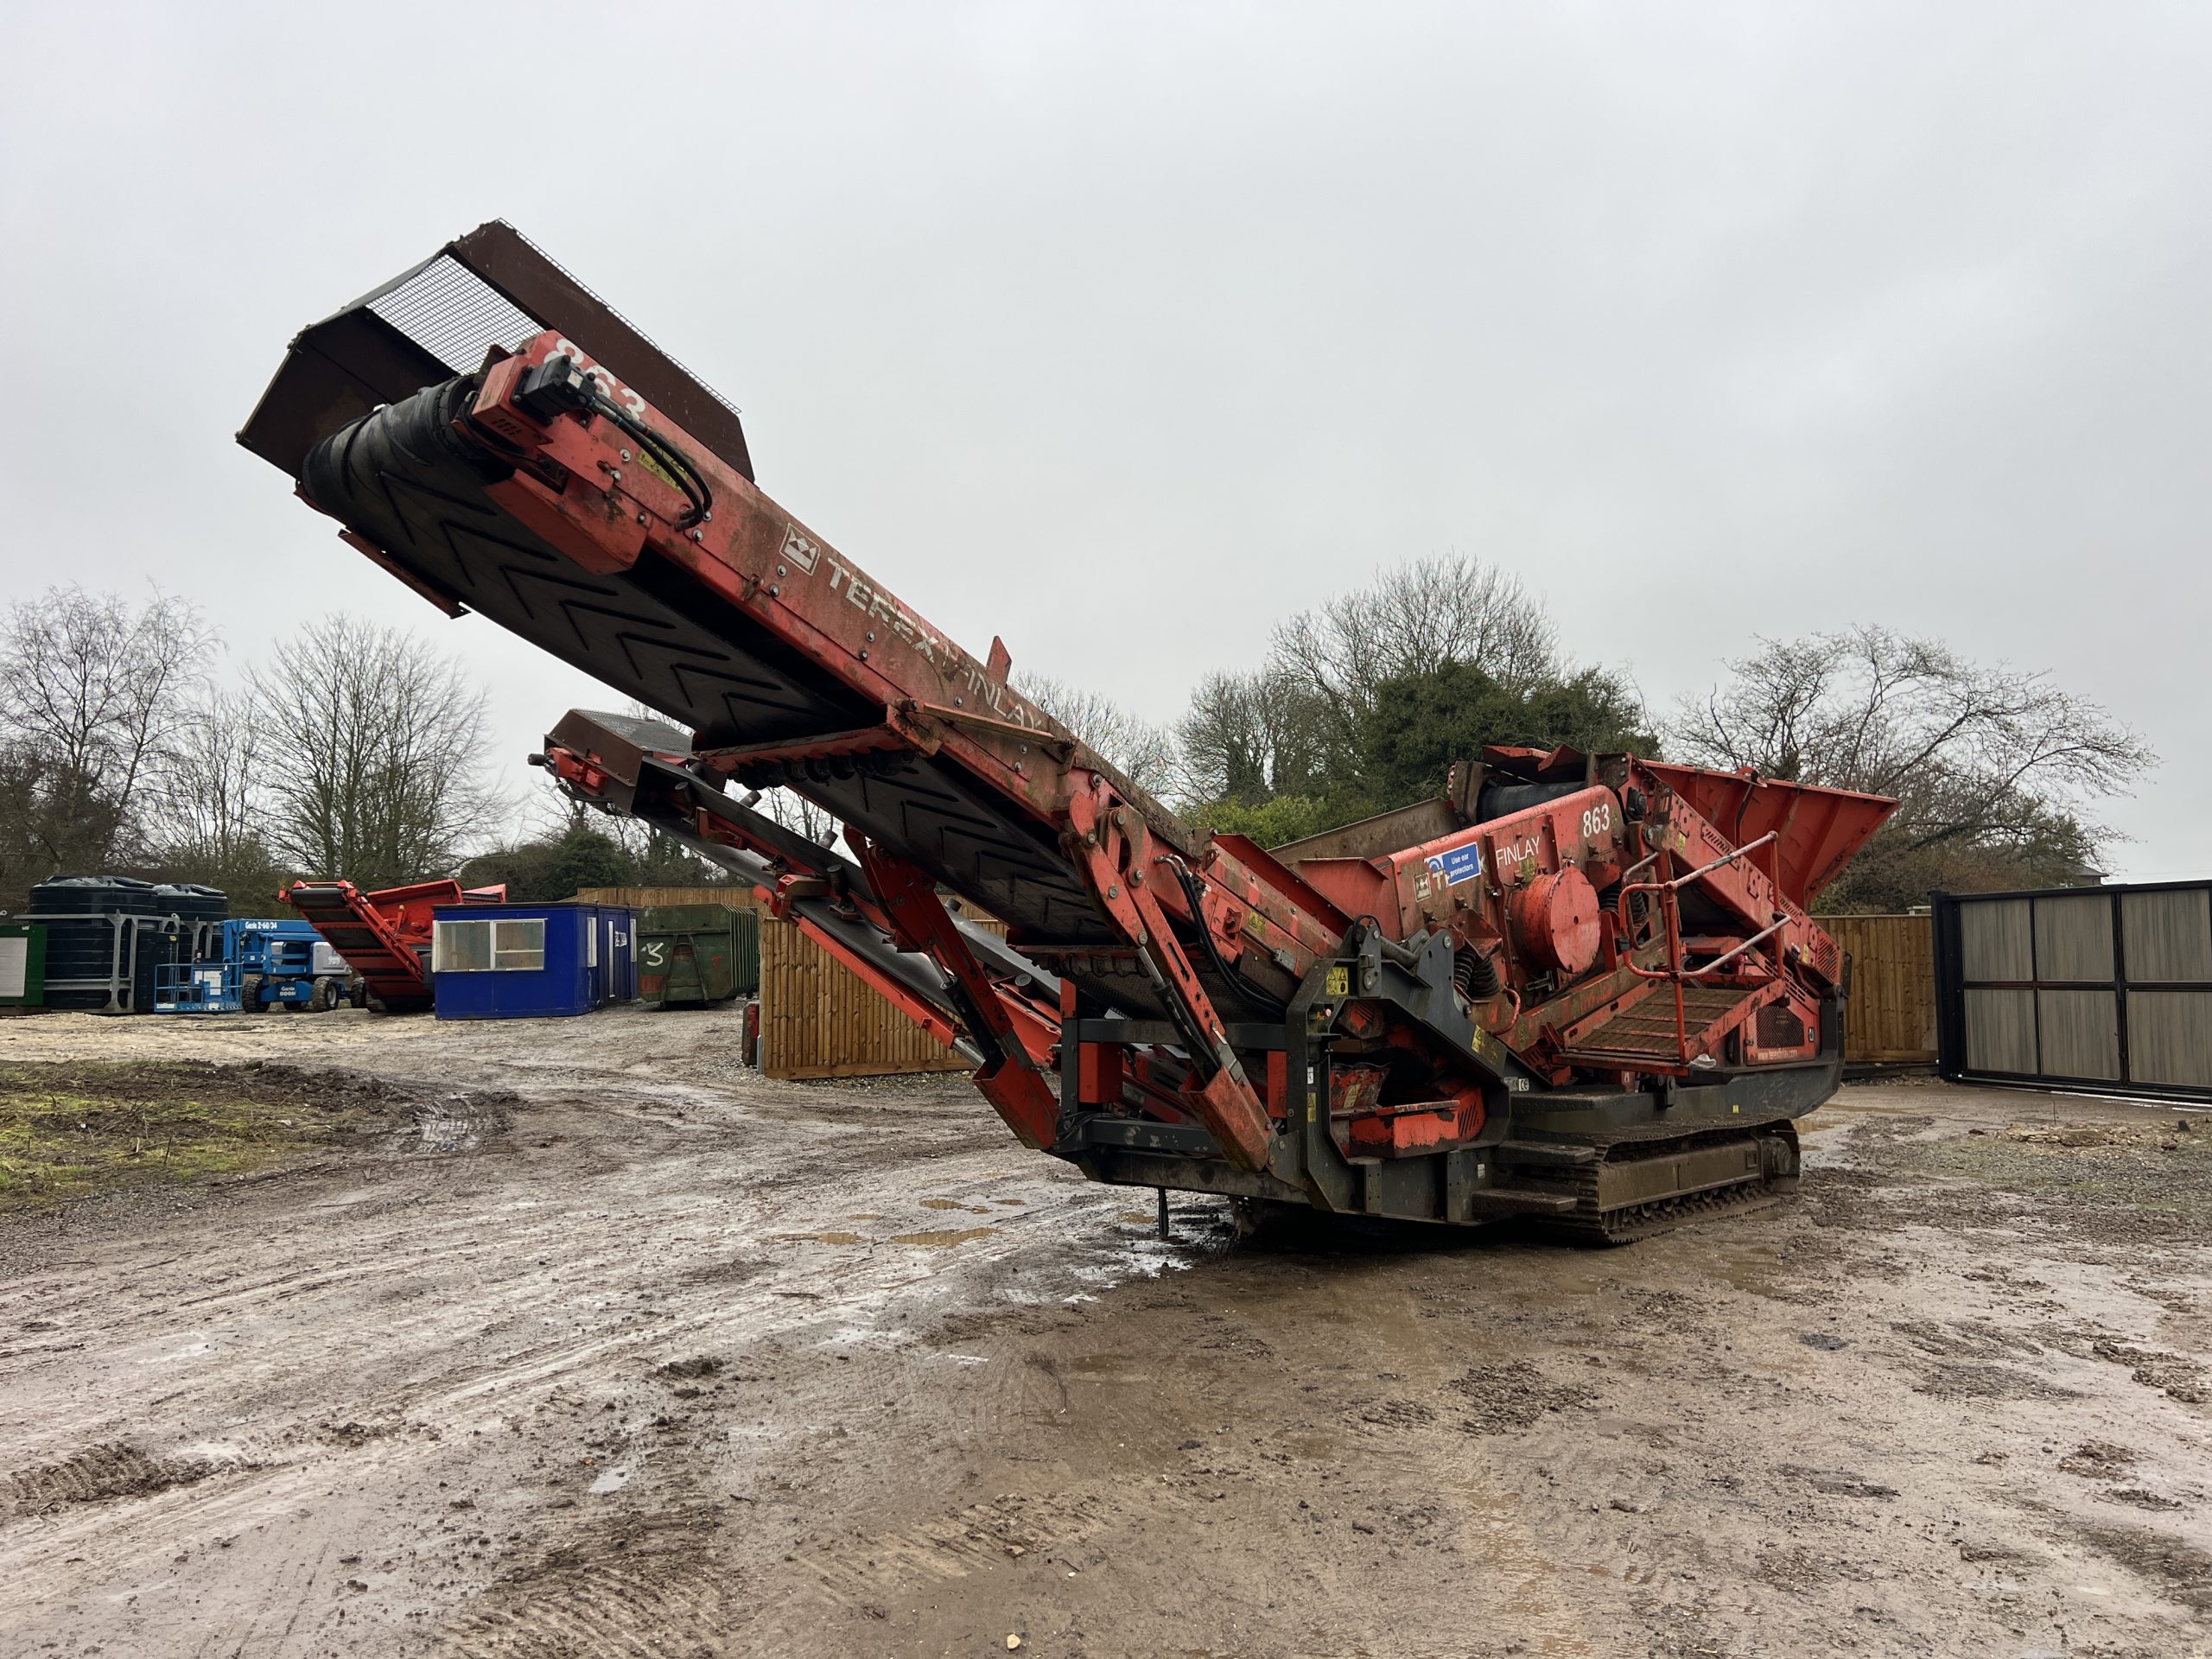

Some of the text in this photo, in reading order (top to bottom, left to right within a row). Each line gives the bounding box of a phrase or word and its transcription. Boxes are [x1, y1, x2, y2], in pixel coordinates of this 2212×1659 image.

[827, 557, 939, 664] TEREX
[1583, 803, 1610, 838] 863
[1451, 853, 1470, 865] Use ear
[1495, 836, 1540, 869] FINLAY
[1449, 863, 1474, 880] protectors
